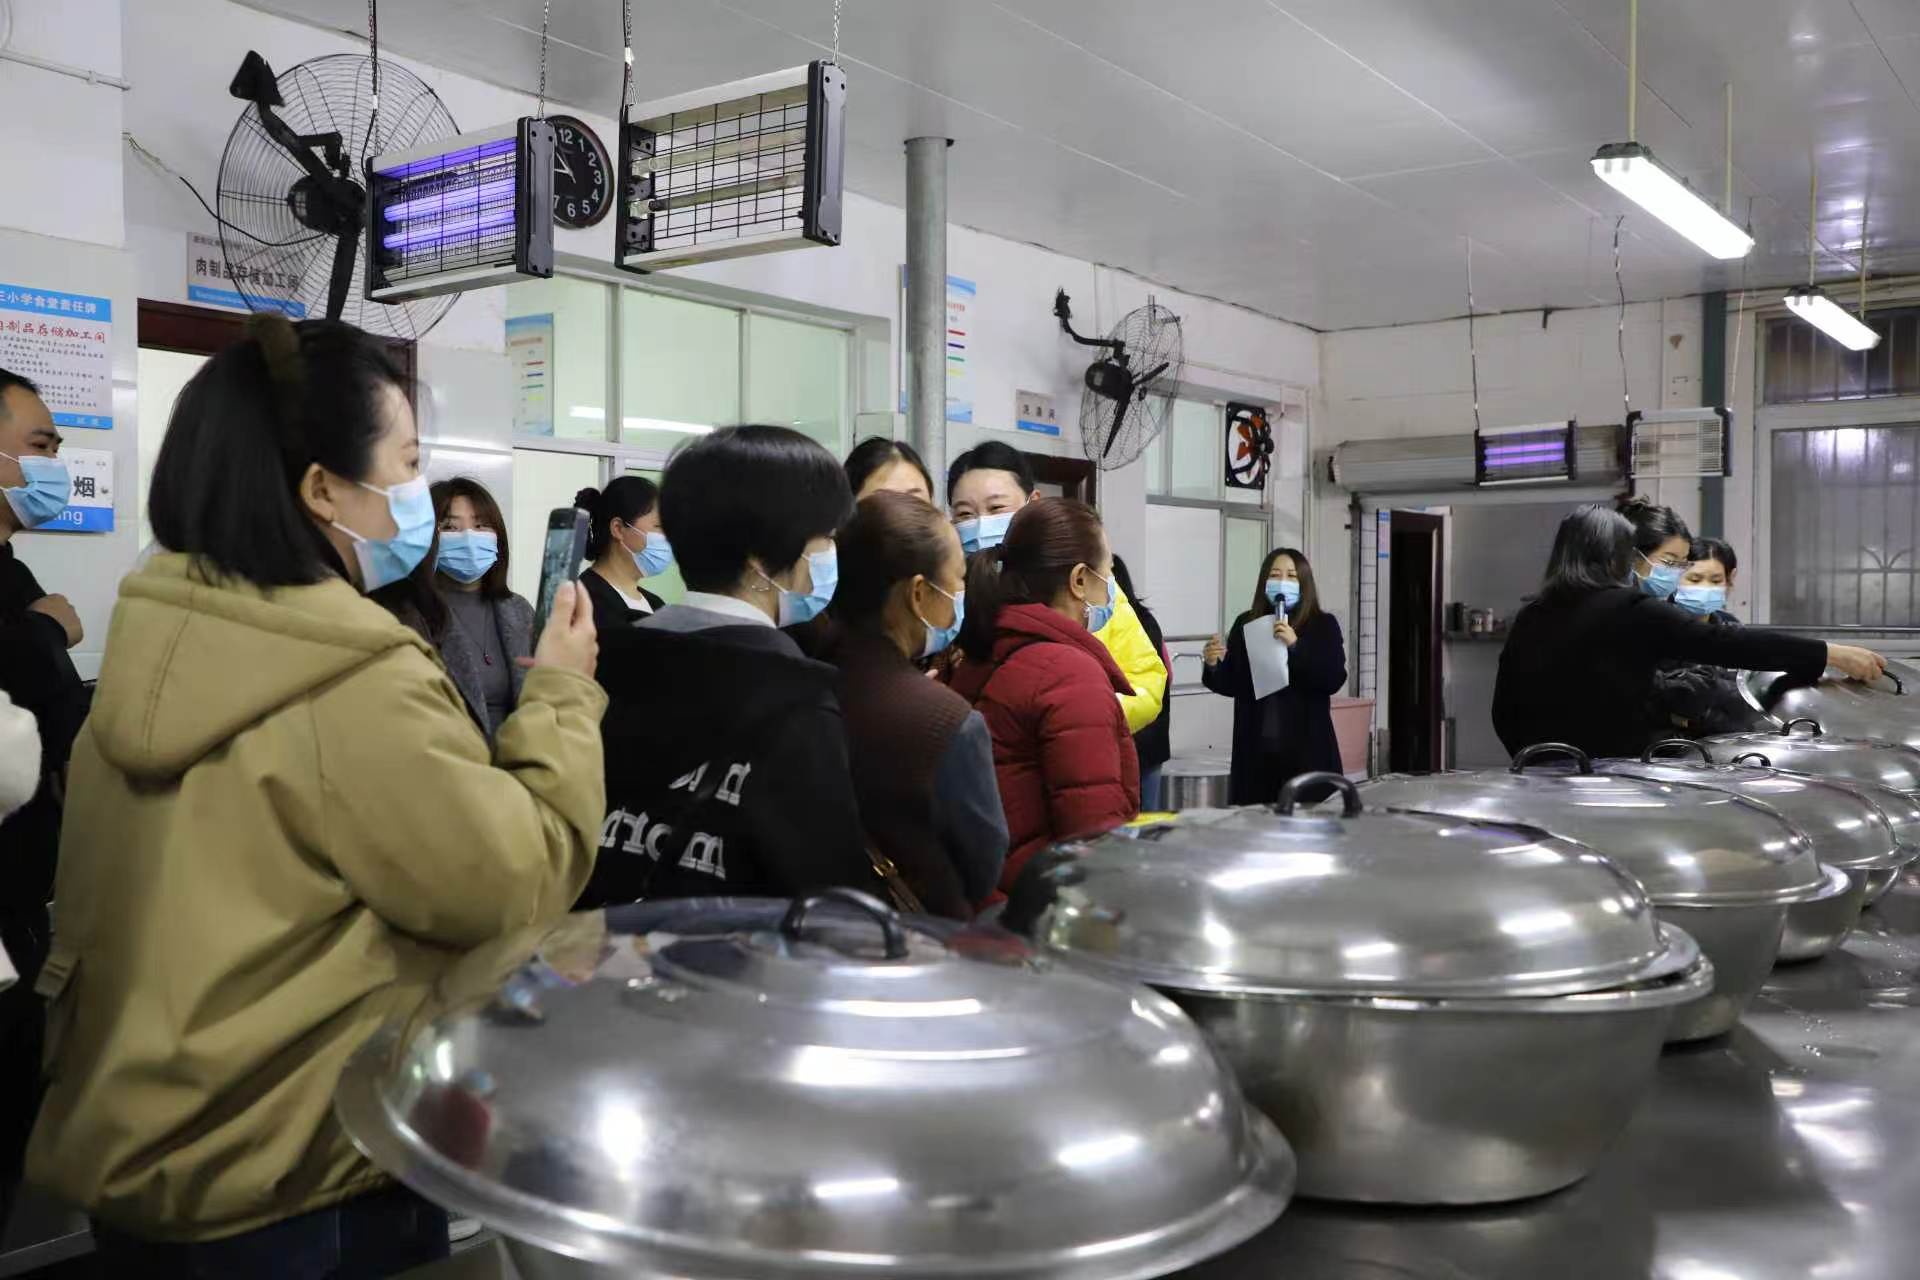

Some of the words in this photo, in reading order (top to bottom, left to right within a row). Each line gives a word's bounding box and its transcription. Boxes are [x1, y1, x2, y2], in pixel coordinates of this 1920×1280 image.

[559, 129, 573, 145] 12
[578, 137, 585, 152] 1
[588, 152, 597, 167] 2
[593, 170, 602, 185] 3
[553, 195, 561, 209] 7
[591, 189, 600, 203] 4
[567, 203, 577, 218] 6
[582, 200, 591, 215] 5
[0, 320, 106, 344] 制品存储加工间
